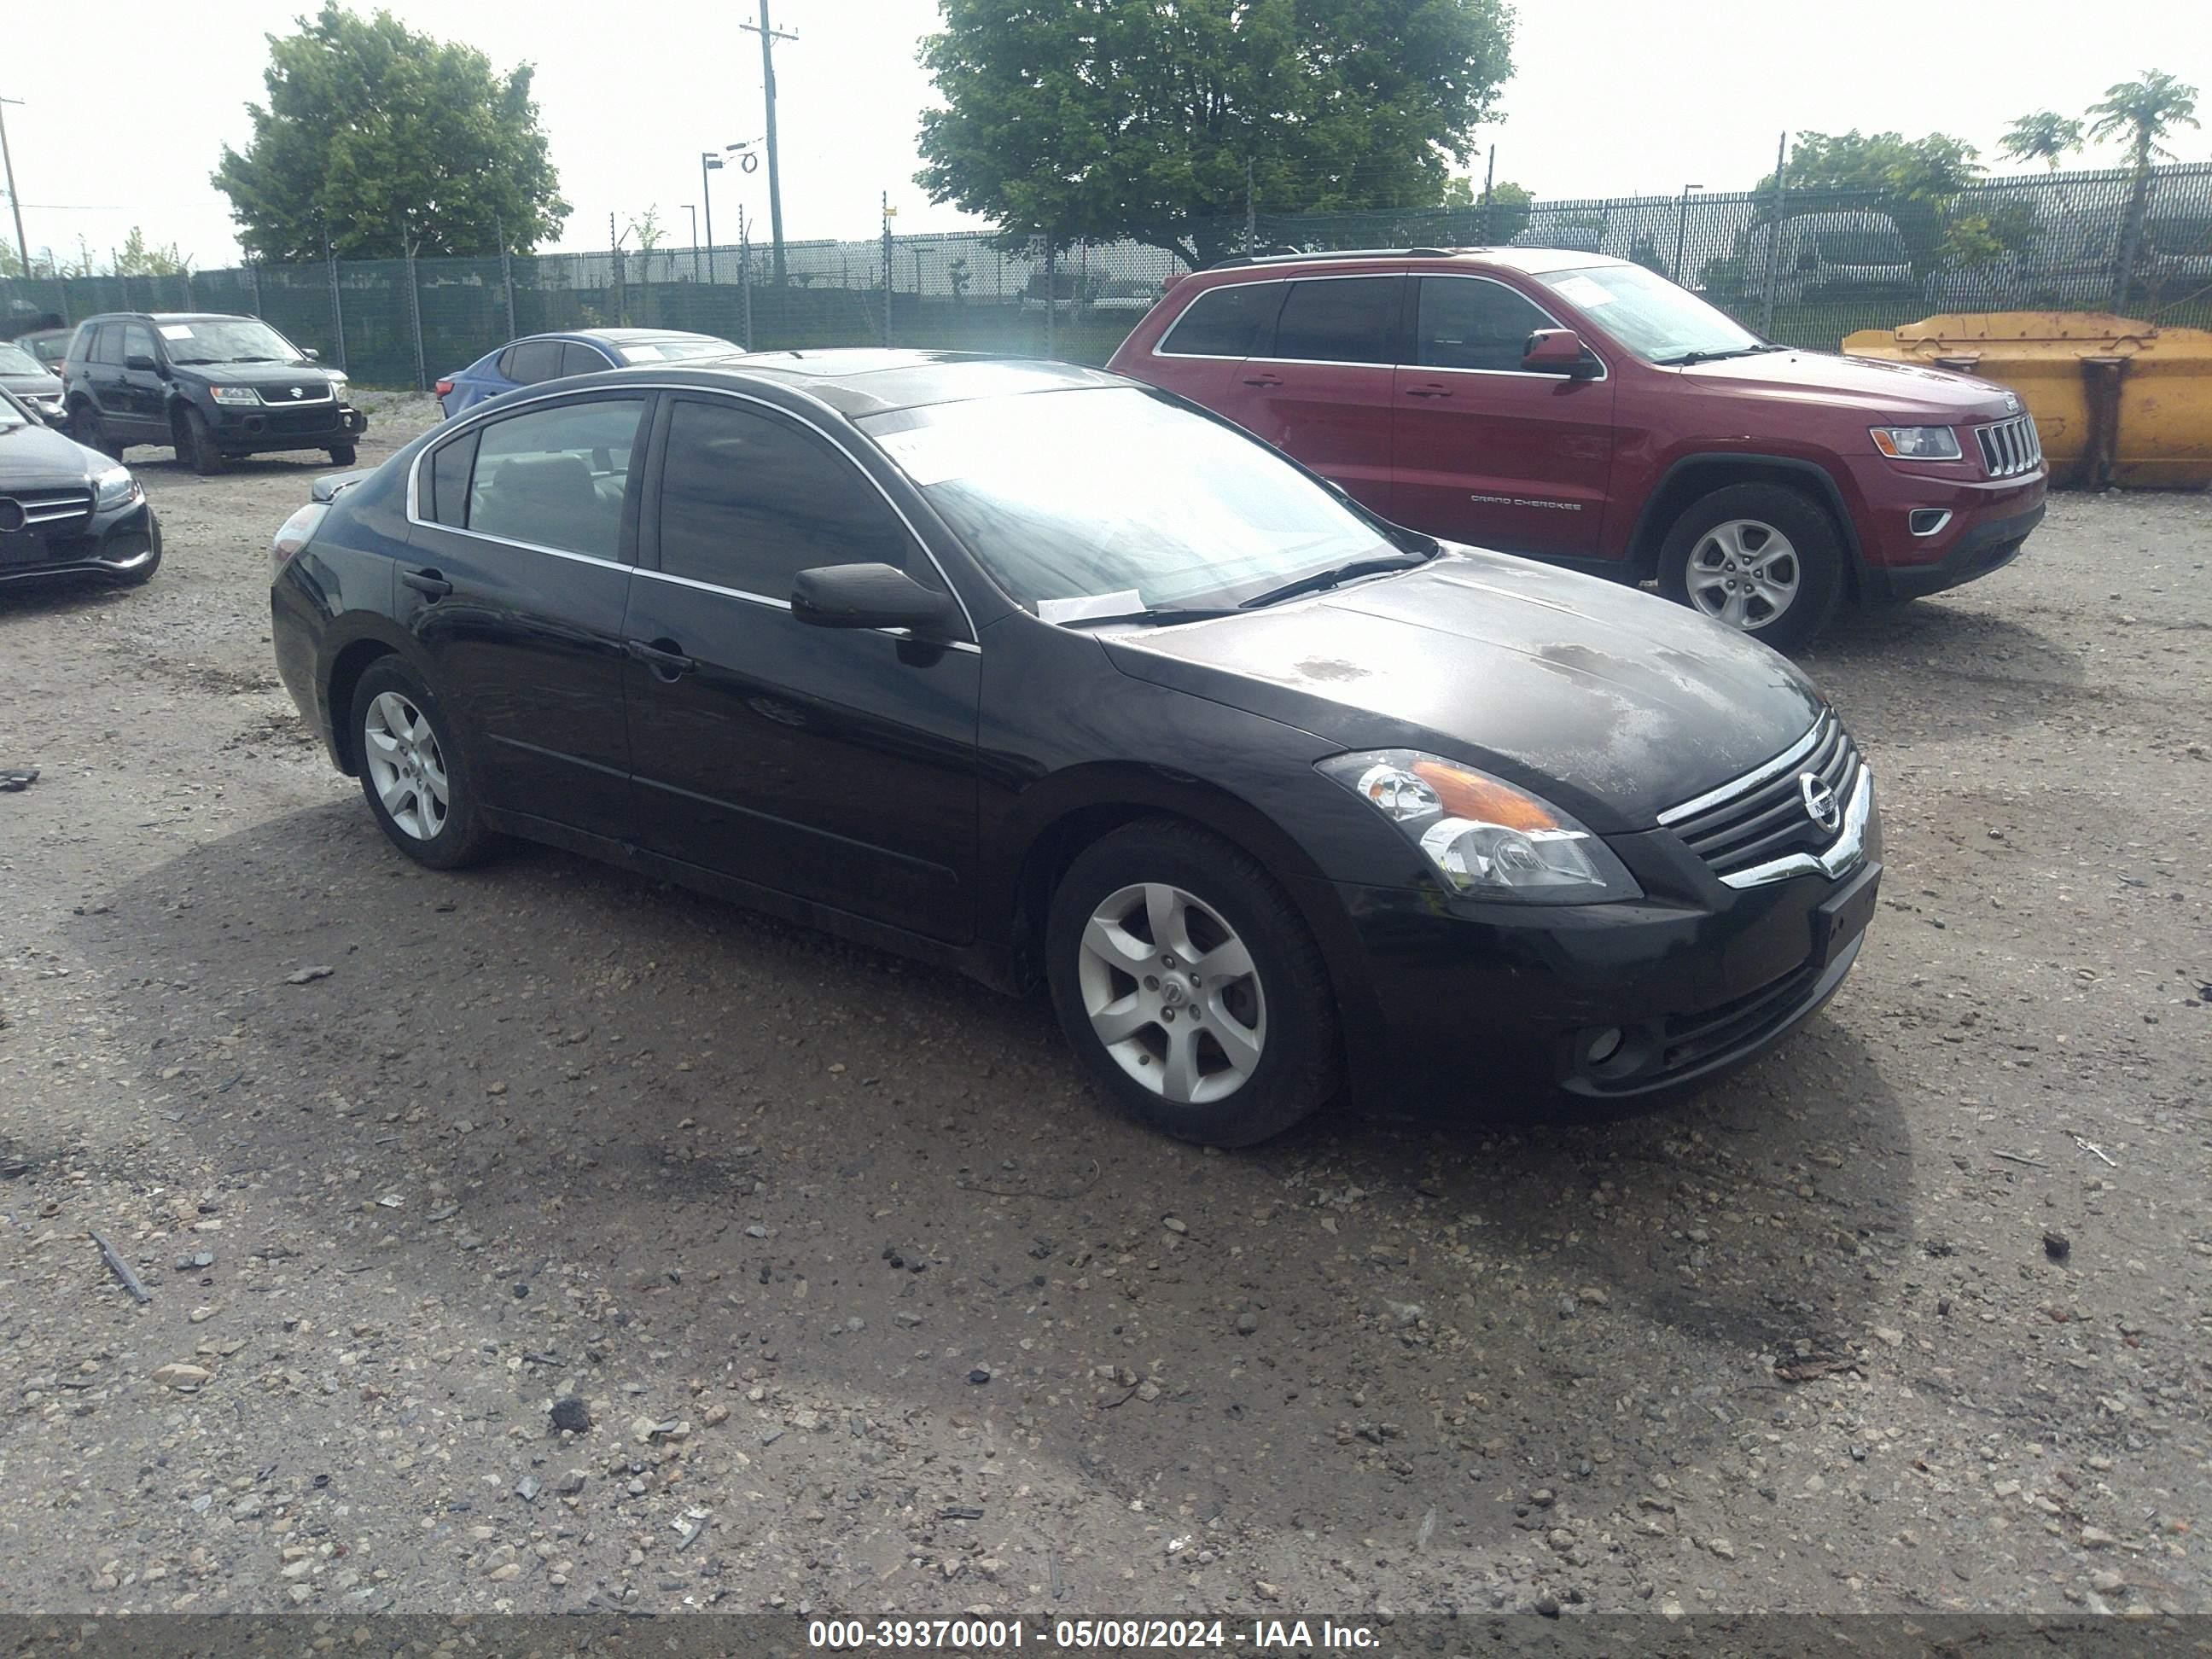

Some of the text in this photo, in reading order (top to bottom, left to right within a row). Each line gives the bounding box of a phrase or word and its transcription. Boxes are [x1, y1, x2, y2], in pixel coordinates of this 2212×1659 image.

[1032, 238, 1046, 256] 25
[1470, 494, 1581, 510] GRAND CHEROKEE
